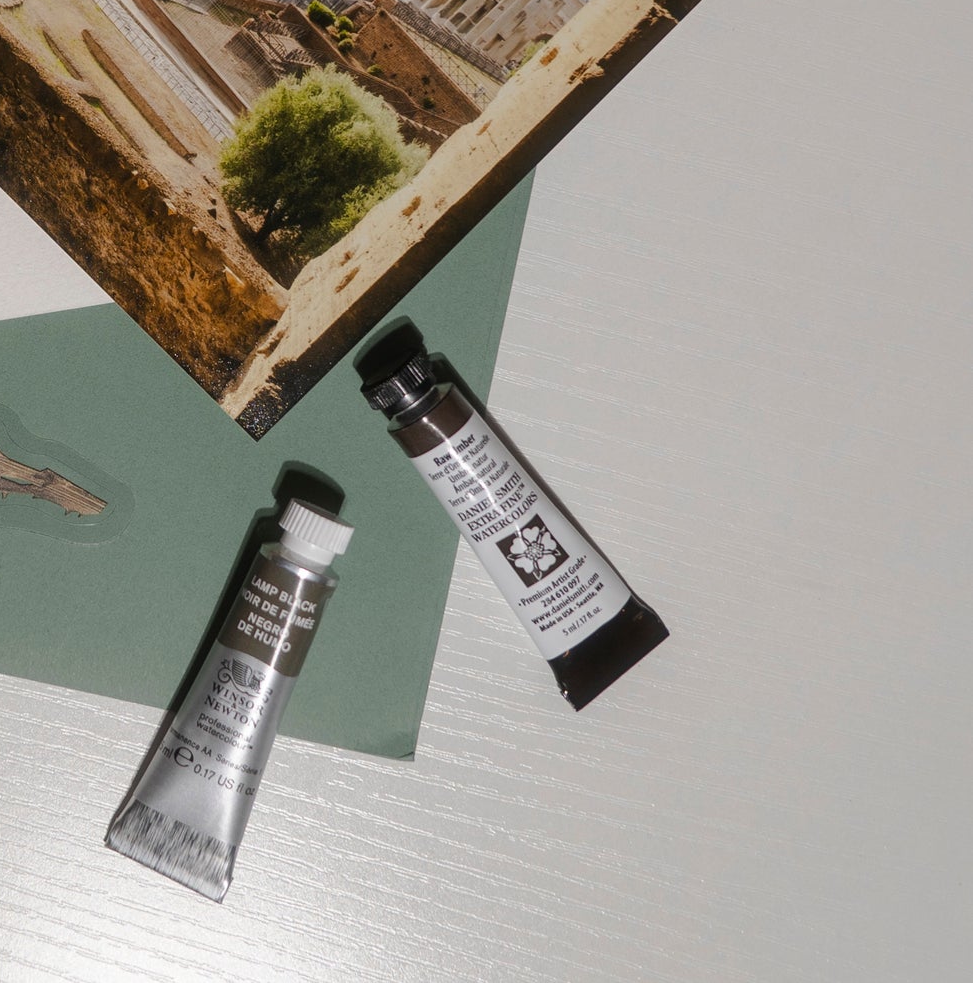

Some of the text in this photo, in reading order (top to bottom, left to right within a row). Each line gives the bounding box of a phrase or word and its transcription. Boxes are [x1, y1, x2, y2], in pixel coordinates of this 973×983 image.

[433, 451, 452, 467] Raw
[494, 471, 522, 500] SMITH
[466, 510, 502, 532] EXTRA
[471, 490, 539, 543] WATERCOLORS
[251, 575, 318, 614] LAMP BLACK
[551, 572, 571, 589] Artist
[260, 599, 280, 617] DE
[538, 619, 557, 632] Made
[556, 615, 564, 624] in
[561, 608, 575, 618] USA
[594, 581, 605, 592] WA
[540, 595, 557, 608] 284
[236, 619, 293, 653] DE HUMO
[247, 611, 291, 638] NEGRO
[562, 627, 570, 636] 5
[204, 694, 261, 729] NEWTON
[212, 681, 265, 716] WINSOR
[198, 712, 253, 743] professional
[201, 746, 213, 758] AA
[193, 763, 216, 781] 0.17
[217, 775, 236, 790] US
[235, 783, 245, 794] fl
